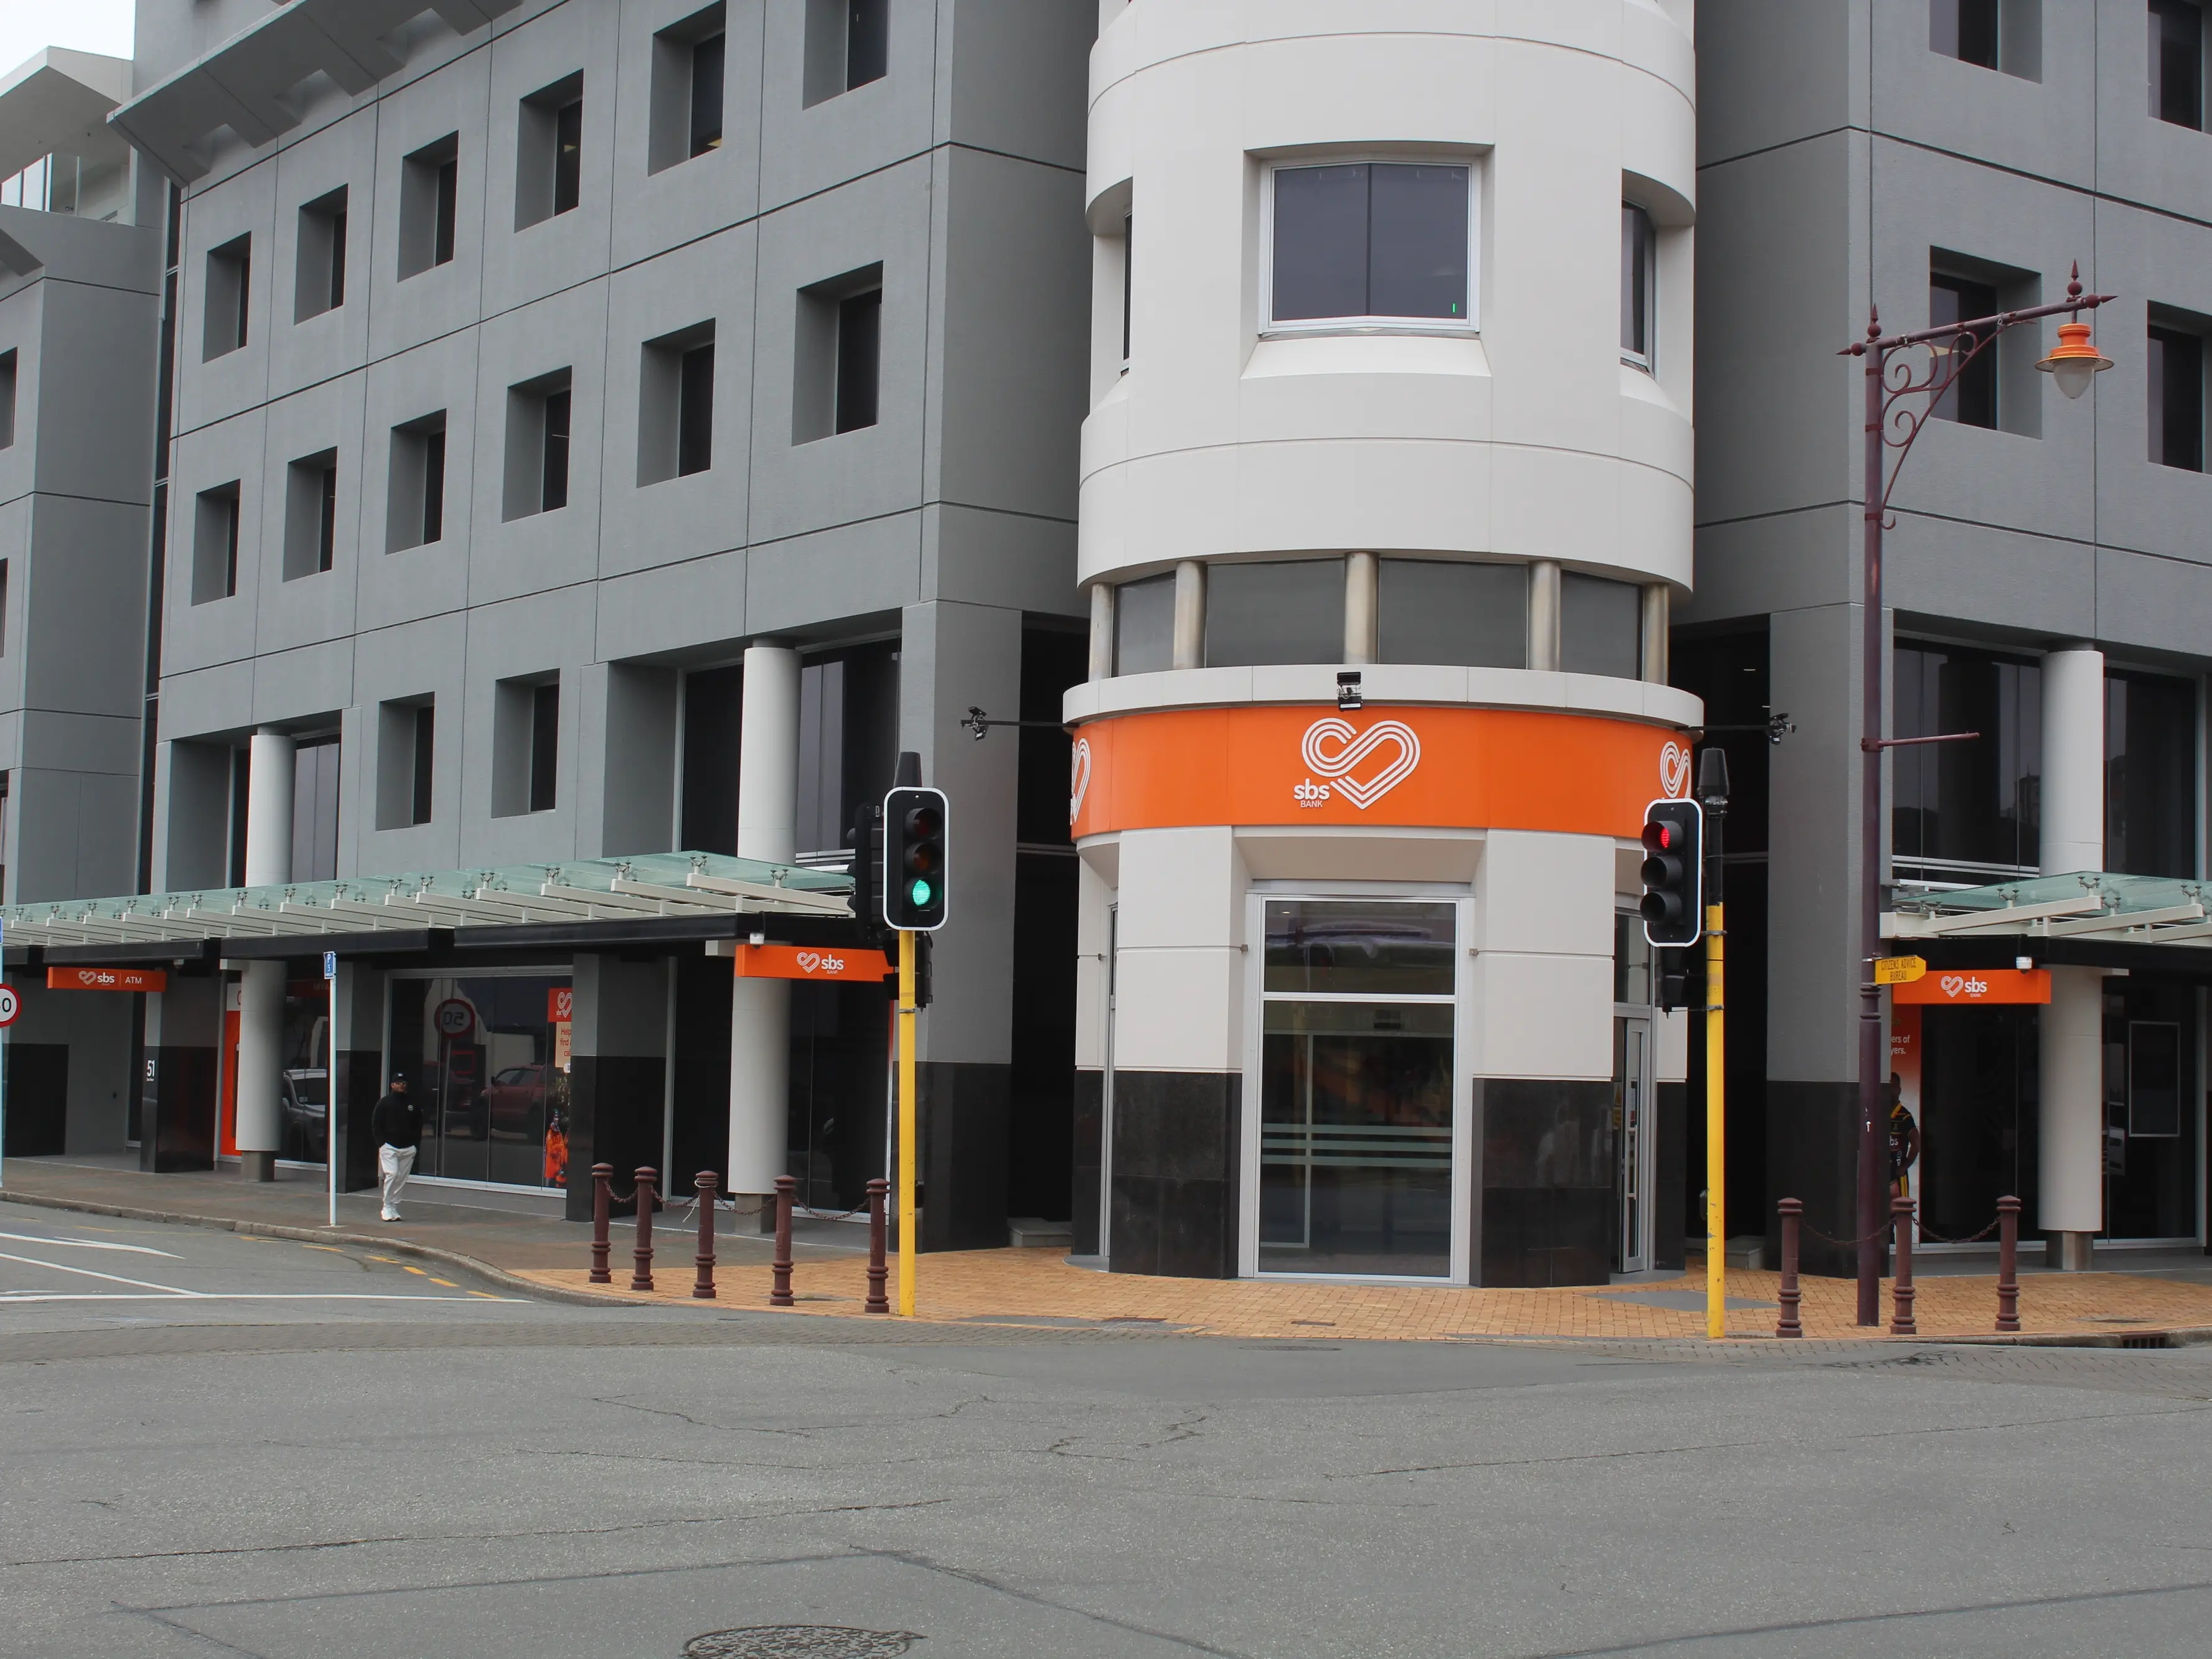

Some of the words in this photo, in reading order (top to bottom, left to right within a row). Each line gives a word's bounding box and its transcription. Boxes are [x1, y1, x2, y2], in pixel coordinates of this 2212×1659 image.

[1294, 778, 1330, 800] sbs
[821, 954, 844, 971] sbs
[1882, 959, 1898, 970] CITIZENS
[1901, 957, 1916, 968] ADVICE
[97, 973, 115, 983] sbs
[125, 976, 142, 984] ATM
[1890, 970, 1906, 981] BUREAU
[1964, 976, 1987, 993] sbs
[0, 998, 11, 1012] 0
[1903, 1034, 1911, 1043] of
[147, 1060, 155, 1077] 51
